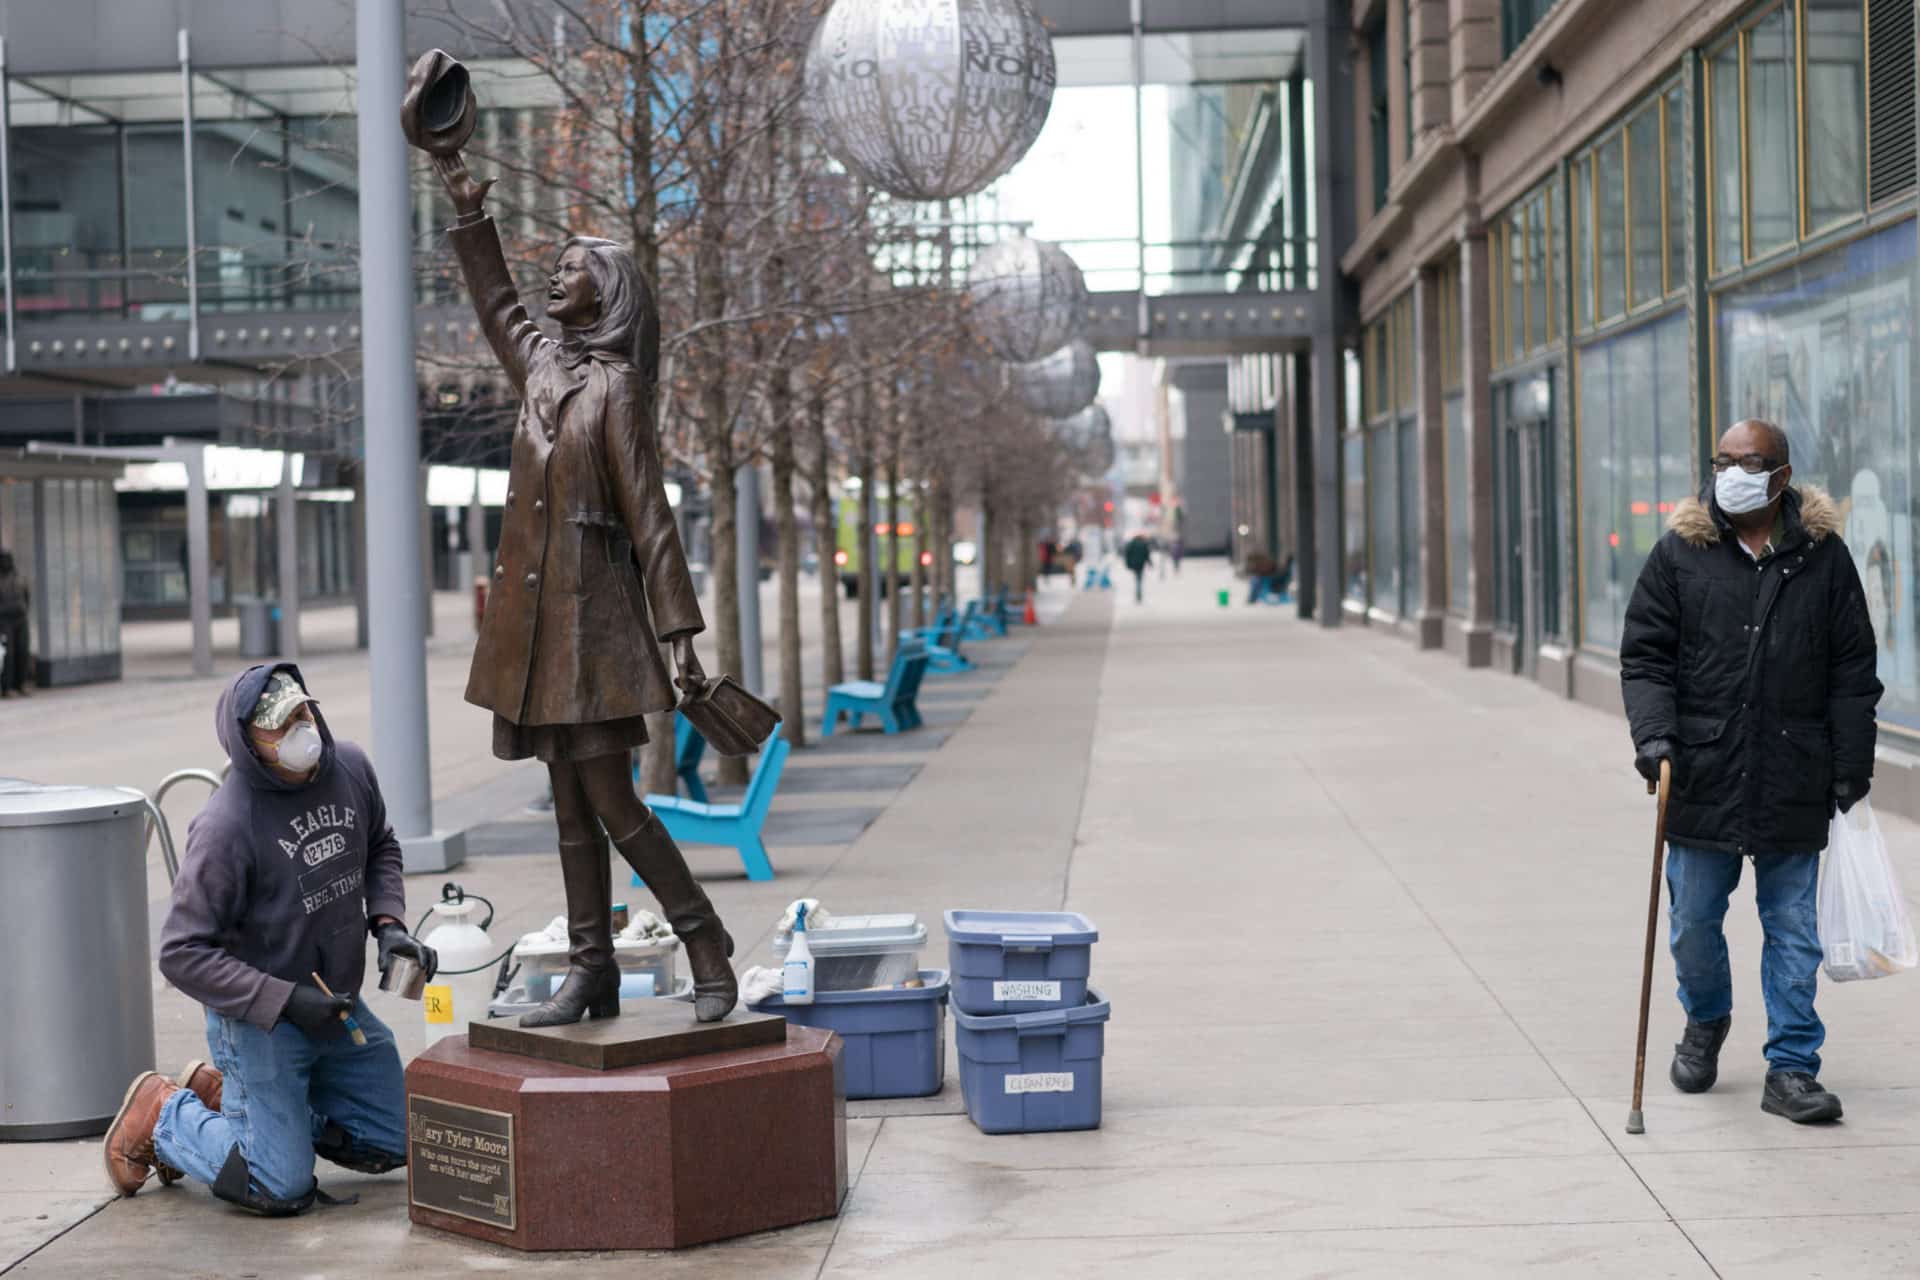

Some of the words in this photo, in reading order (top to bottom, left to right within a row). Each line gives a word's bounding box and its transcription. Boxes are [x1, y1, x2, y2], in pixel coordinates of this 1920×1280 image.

[305, 834, 344, 863] 127-76
[1001, 983, 1052, 996] WASHING
[445, 1130, 473, 1148] Tyler
[475, 1136, 507, 1156] Moore
[468, 1159, 480, 1171] the
